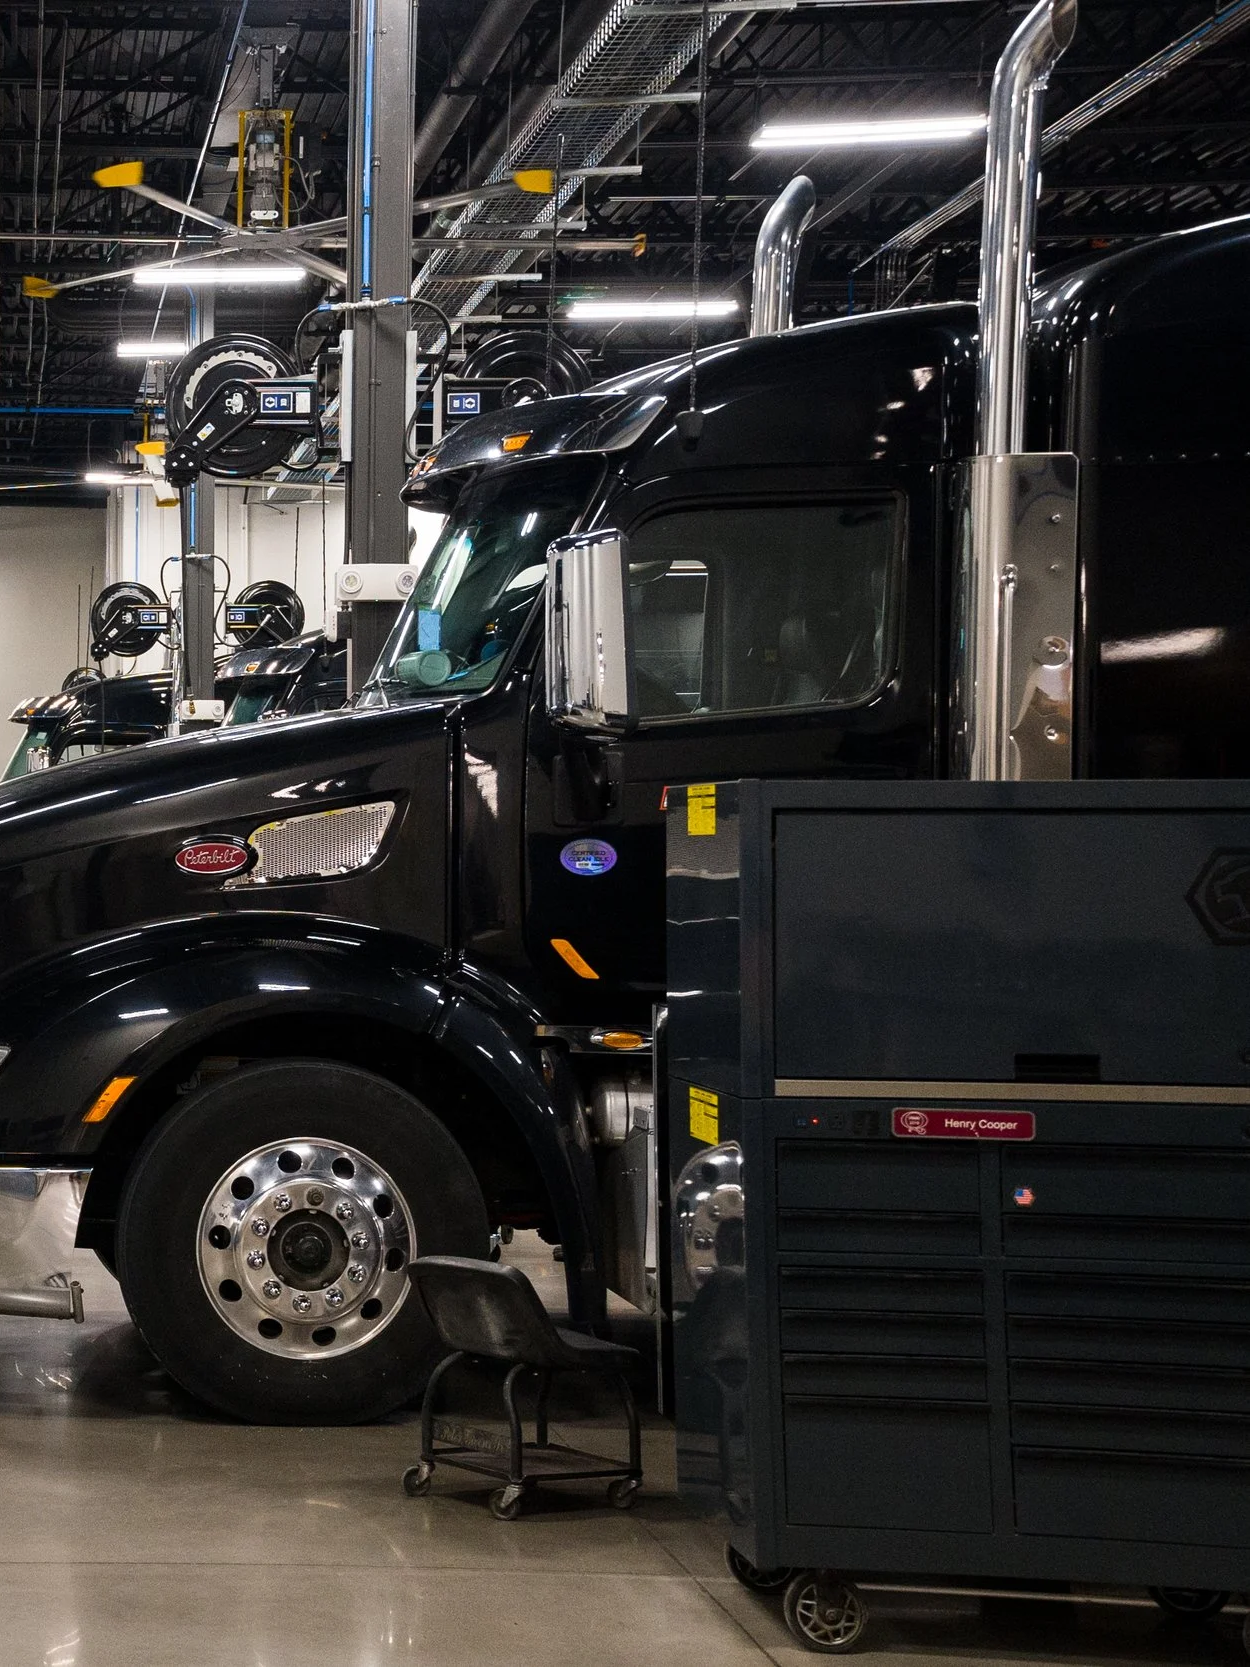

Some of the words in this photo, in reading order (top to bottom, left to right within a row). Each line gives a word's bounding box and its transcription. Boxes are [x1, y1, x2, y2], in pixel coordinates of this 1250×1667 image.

[184, 849, 240, 867] Peterbilt
[944, 1118, 977, 1131] Henry
[978, 1119, 1018, 1132] Cooper
